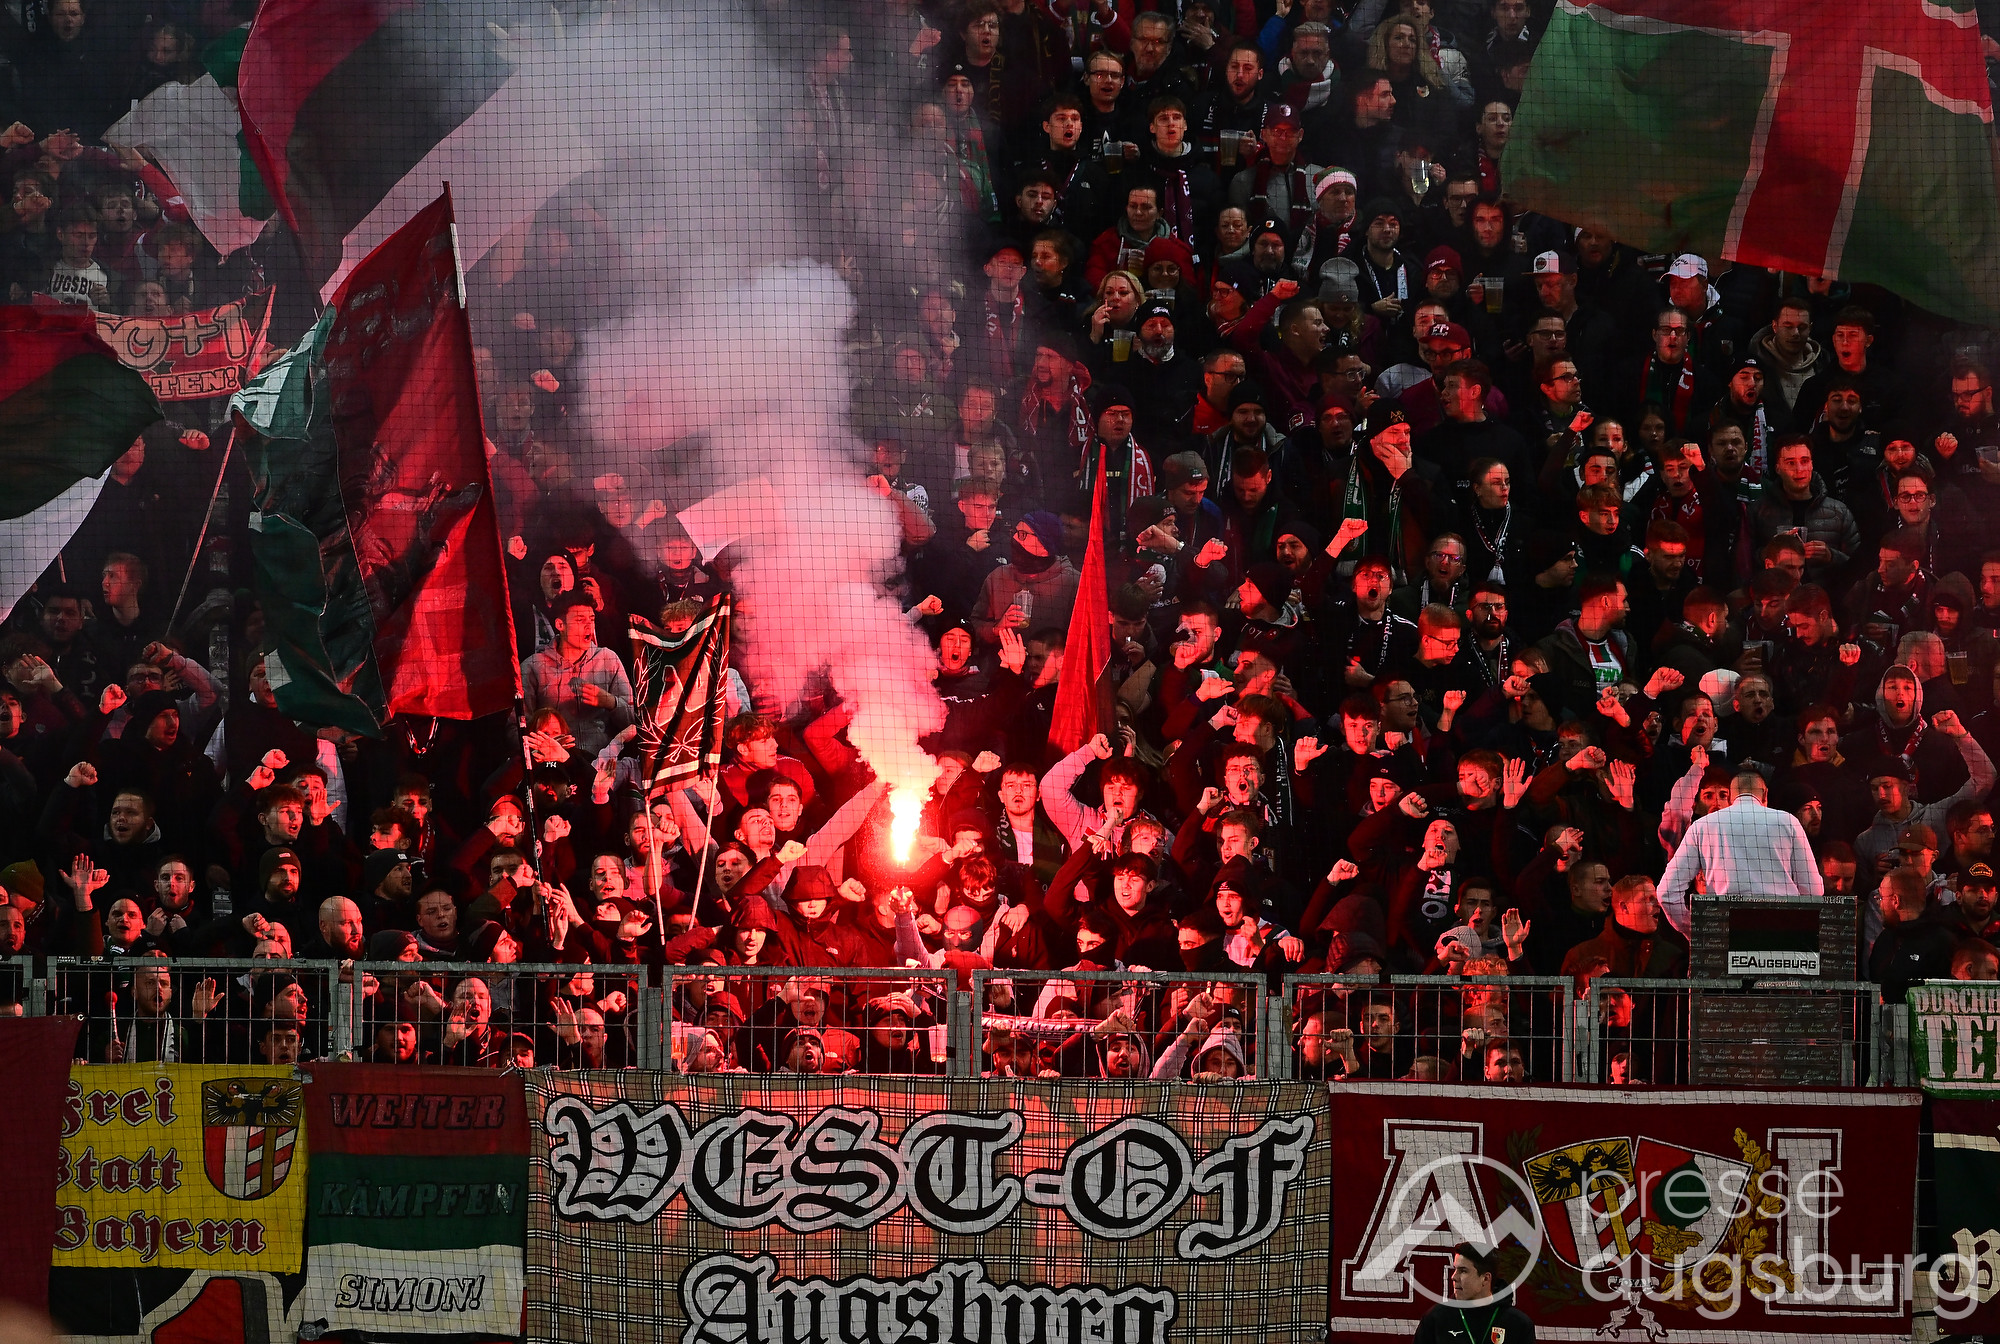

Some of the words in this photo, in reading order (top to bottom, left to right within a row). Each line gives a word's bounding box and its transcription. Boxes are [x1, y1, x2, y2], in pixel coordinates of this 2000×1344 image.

[51, 273, 94, 294] UGSBU
[152, 367, 237, 396] TEN!
[330, 1092, 505, 1129] WEITER
[317, 1178, 520, 1218] KÄMPFEN
[53, 1205, 267, 1263] Bayern
[335, 1273, 485, 1312] SIMON!
